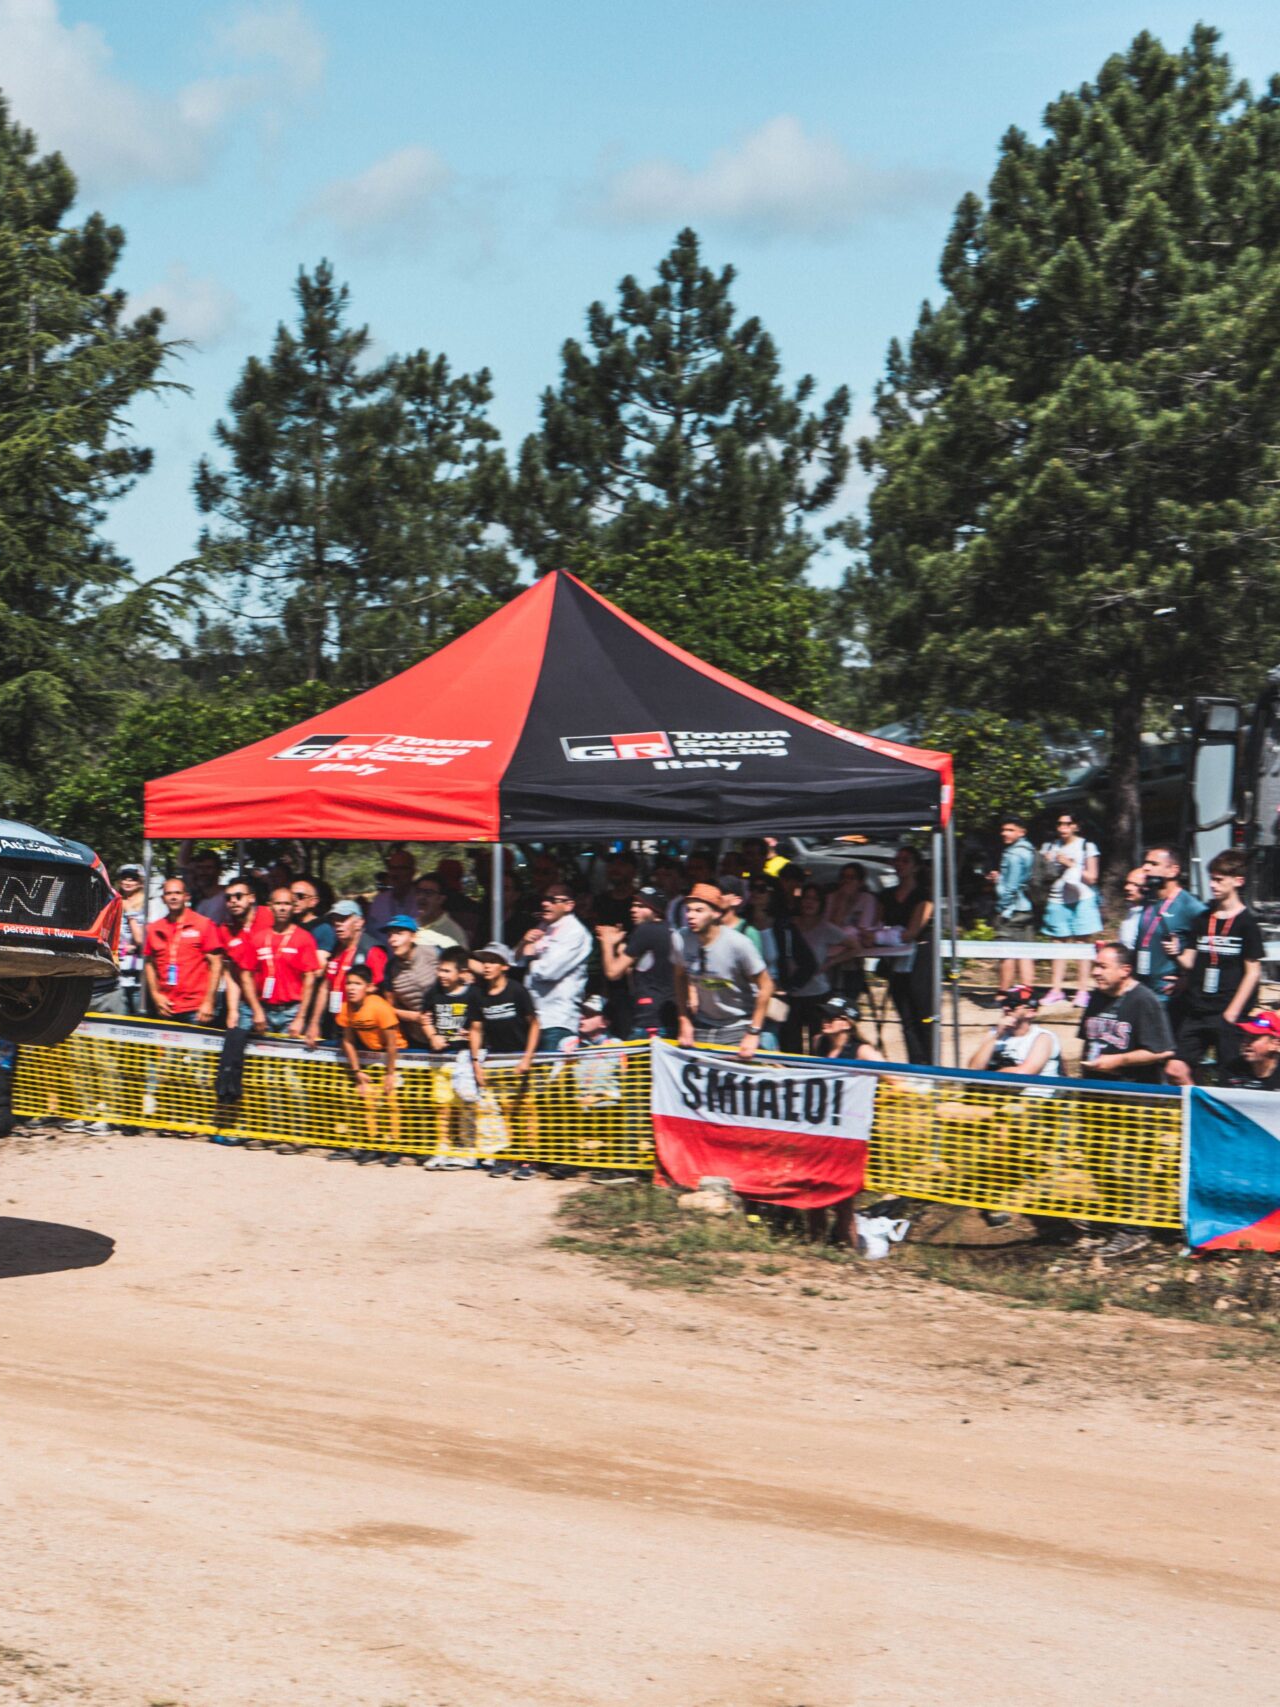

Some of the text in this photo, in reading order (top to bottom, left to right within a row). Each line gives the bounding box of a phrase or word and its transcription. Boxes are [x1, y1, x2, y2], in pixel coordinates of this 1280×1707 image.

[275, 744, 372, 761] GR
[569, 742, 667, 760] GR
[308, 762, 389, 776] Italy
[652, 758, 743, 771] Italy
[3, 925, 45, 935] personal
